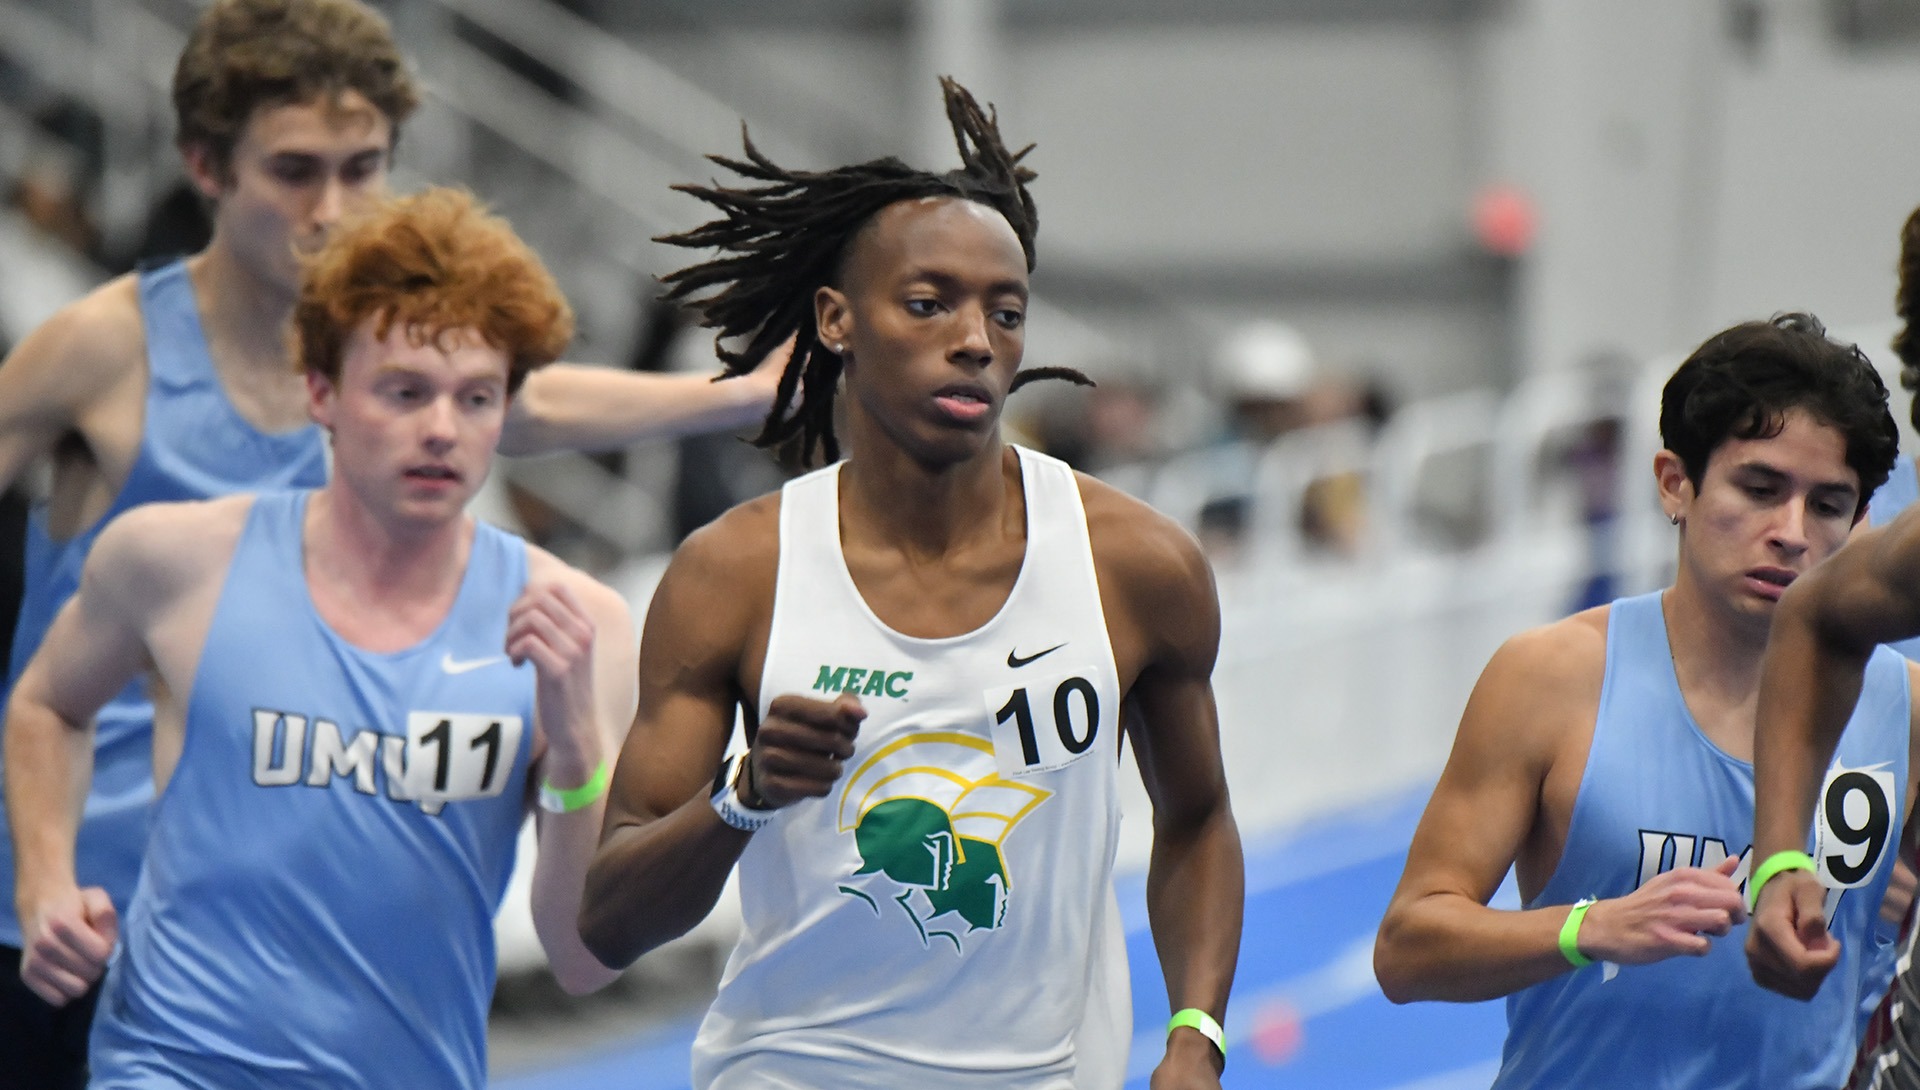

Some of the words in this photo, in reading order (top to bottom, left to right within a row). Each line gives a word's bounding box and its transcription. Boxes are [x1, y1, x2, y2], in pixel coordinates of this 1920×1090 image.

[812, 665, 914, 698] MEAC
[996, 676, 1100, 767] 10
[419, 719, 501, 791] 11
[1825, 771, 1890, 885] 9
